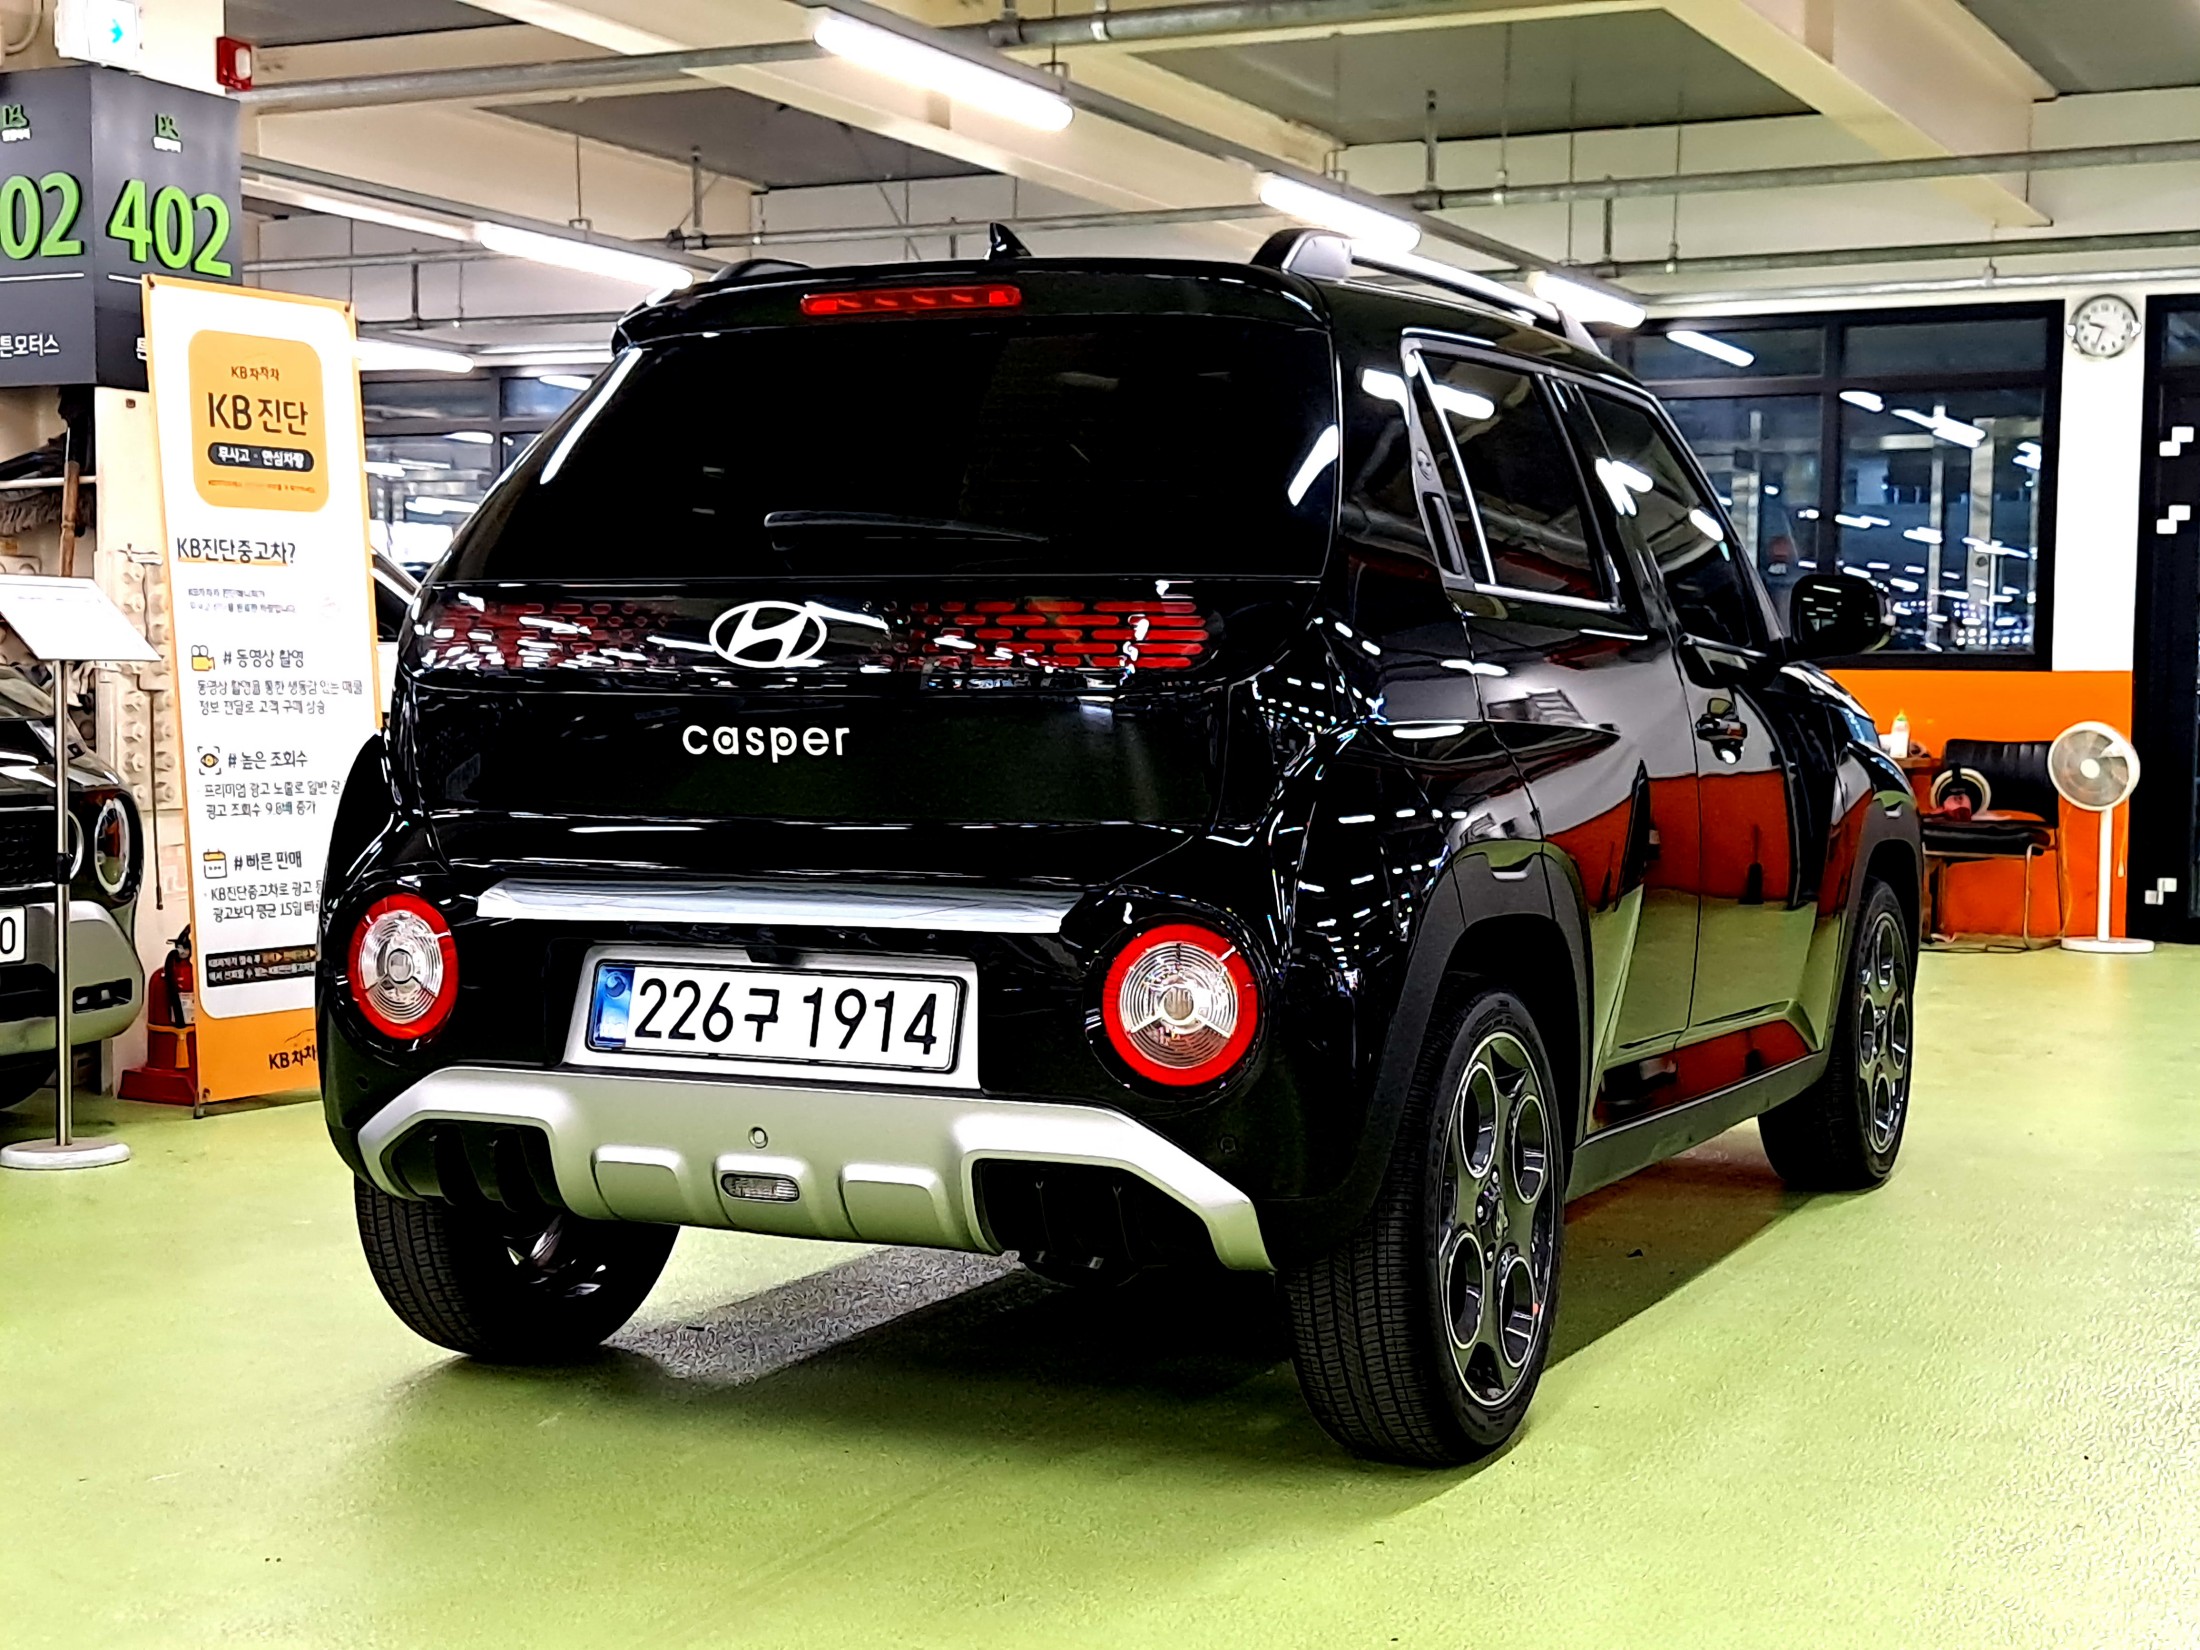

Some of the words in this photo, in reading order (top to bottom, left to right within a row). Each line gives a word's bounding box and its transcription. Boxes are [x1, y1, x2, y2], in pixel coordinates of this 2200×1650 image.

[107, 179, 233, 278] 402
[177, 537, 296, 564] KB진단중고차?
[236, 649, 275, 668] 동영상
[279, 649, 304, 668] 촬영
[682, 724, 850, 763] casper
[240, 751, 267, 770] 높은
[270, 750, 308, 767] 조회수
[204, 783, 246, 798] 프리미엄
[246, 852, 274, 871] 빠른
[276, 850, 302, 870] 판매
[211, 882, 290, 901] KB진단중고차로
[213, 904, 254, 923] 광고보다
[634, 977, 780, 1043] 226구
[802, 986, 938, 1056] 1914
